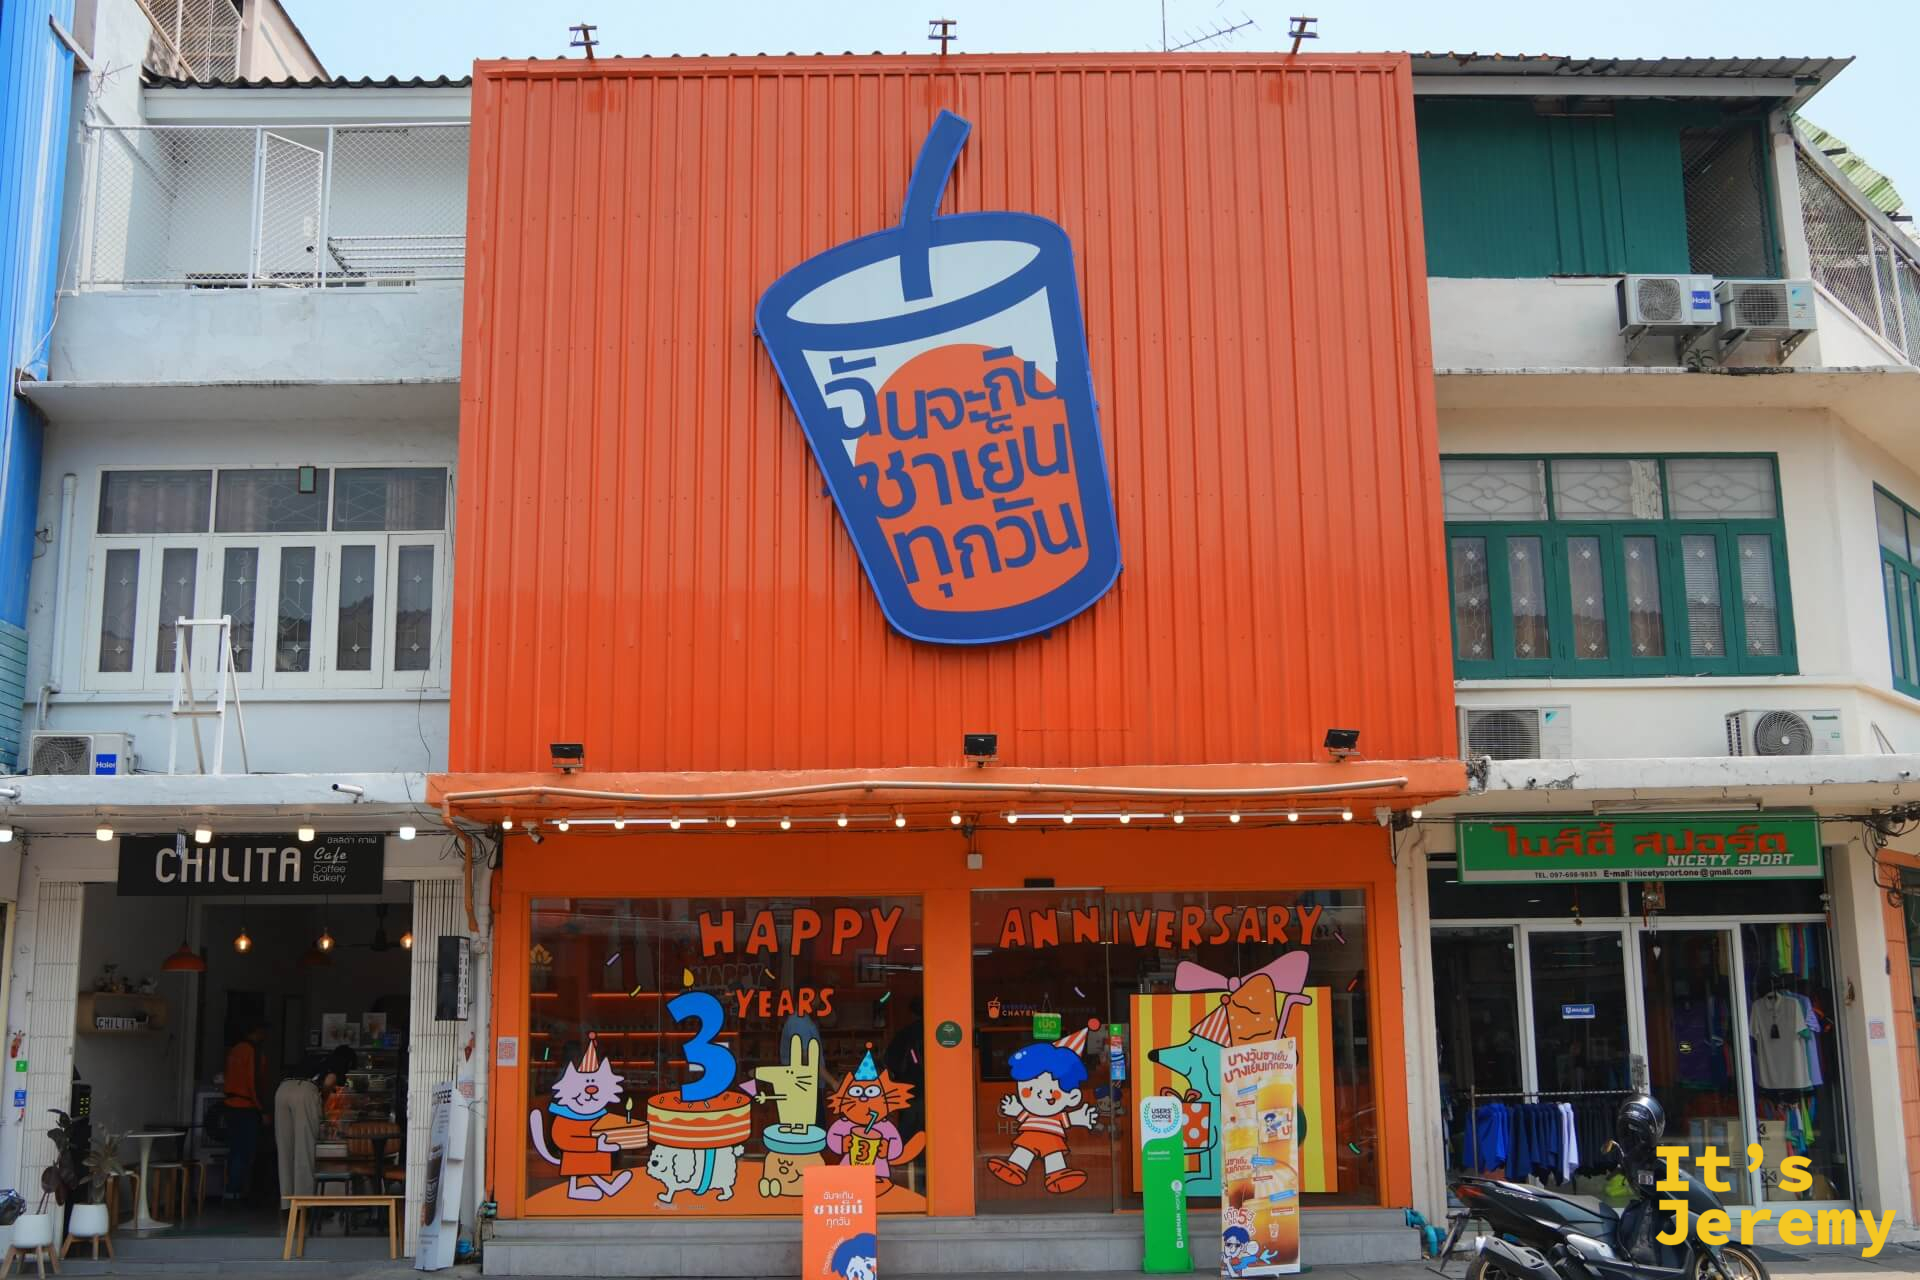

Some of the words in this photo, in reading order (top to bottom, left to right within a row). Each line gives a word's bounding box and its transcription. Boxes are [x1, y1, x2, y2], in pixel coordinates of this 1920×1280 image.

[893, 497, 1082, 599] ทุกวัน
[155, 847, 302, 883] CHILITA
[313, 847, 347, 864] Cafe
[313, 864, 346, 873] Coffee
[1667, 854, 1732, 867] NICETY
[1738, 853, 1794, 866] SPORT
[312, 873, 346, 884] Bakery
[699, 906, 903, 958] HAPPY
[999, 904, 1322, 950] ANNIVERSARY
[666, 991, 738, 1102] 3
[735, 987, 835, 1019] YEARS
[856, 1140, 870, 1162] 3
